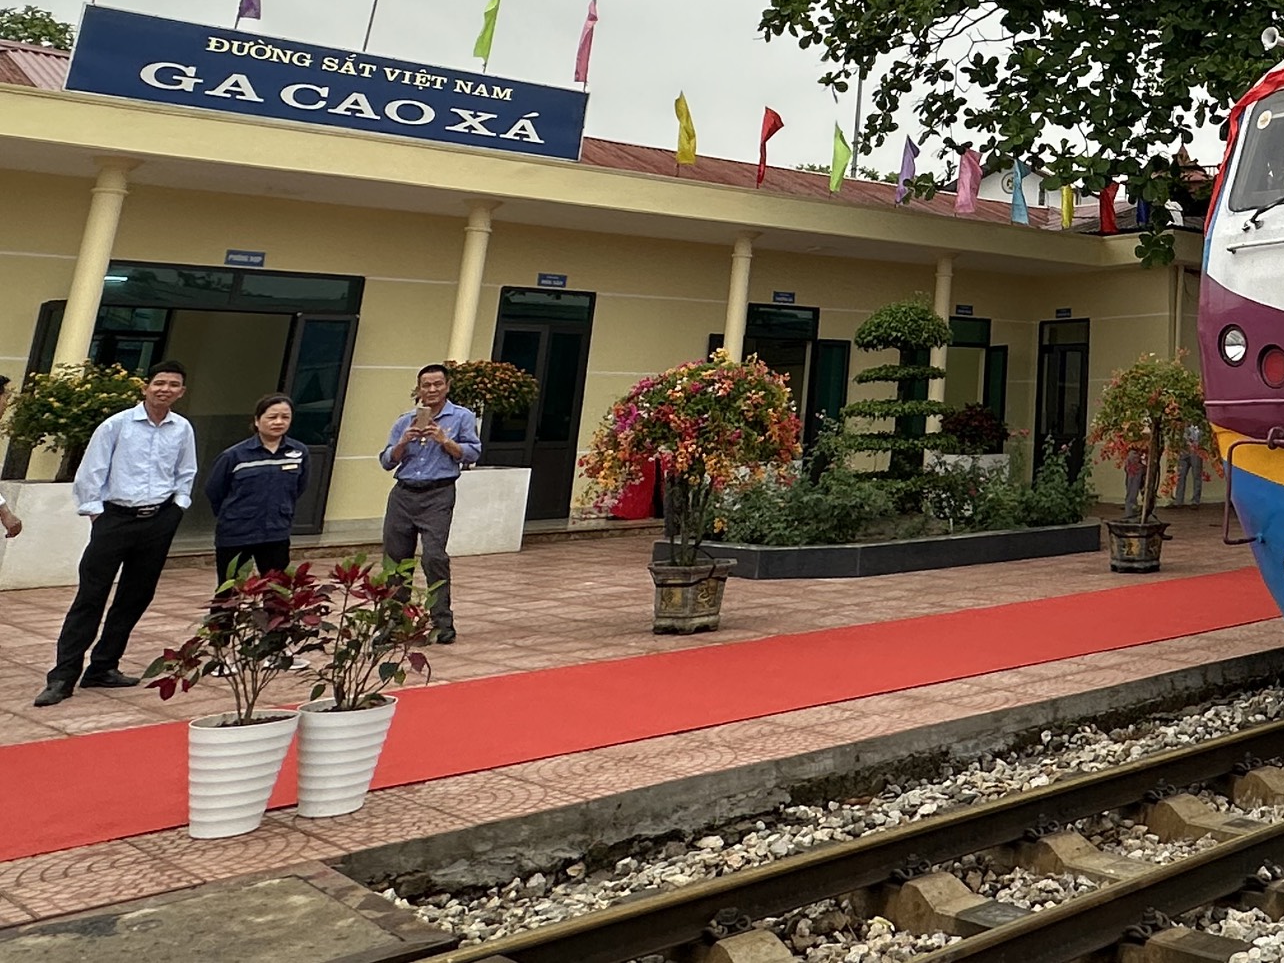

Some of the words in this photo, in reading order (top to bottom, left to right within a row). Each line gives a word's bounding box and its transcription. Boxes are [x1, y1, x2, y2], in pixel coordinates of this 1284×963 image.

[139, 62, 264, 103] GA
[280, 83, 436, 126] CAO
[445, 107, 545, 144] XÁ
[205, 37, 313, 68] ĐƯỜNG
[321, 54, 377, 79] SẮT
[383, 68, 448, 91] VIỆT
[454, 79, 513, 101] NAM
